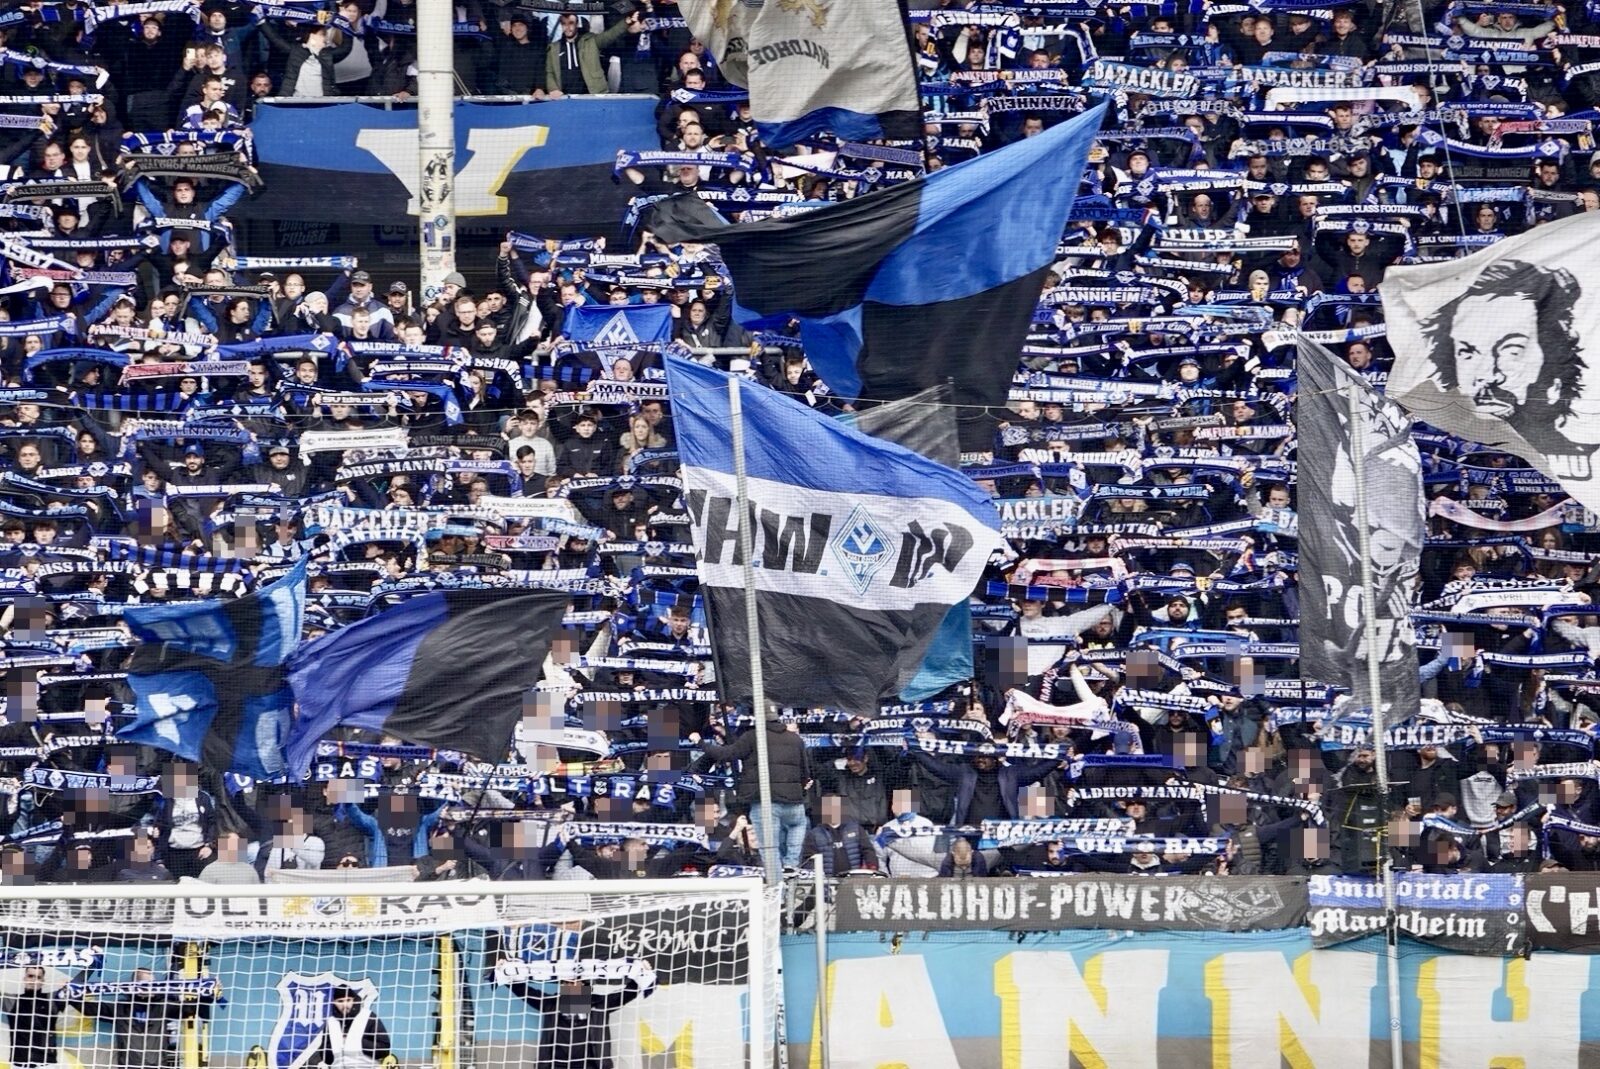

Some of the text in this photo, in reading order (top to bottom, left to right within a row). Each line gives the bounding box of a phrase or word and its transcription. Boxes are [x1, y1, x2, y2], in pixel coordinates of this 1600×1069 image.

[1388, 35, 1442, 46] WALDHOF
[951, 71, 997, 81] RANKFURT
[1095, 61, 1196, 93] BARACKLER
[1243, 68, 1346, 88] BARACKLER
[988, 97, 1077, 112] MANNHEIM
[72, 240, 98, 248] CLASS
[99, 239, 140, 247] FOOTBALL
[1063, 269, 1110, 279] ALDHOF
[1053, 291, 1144, 303] MANNHEIM
[595, 384, 668, 396] MANNH
[1158, 579, 1195, 588] immer
[1341, 725, 1457, 747] BAACKLER
[318, 759, 376, 780] RAS
[614, 782, 673, 803] RAS
[1077, 838, 1219, 854] ULT RAS
[855, 881, 1187, 921] WALDHOF-POWER
